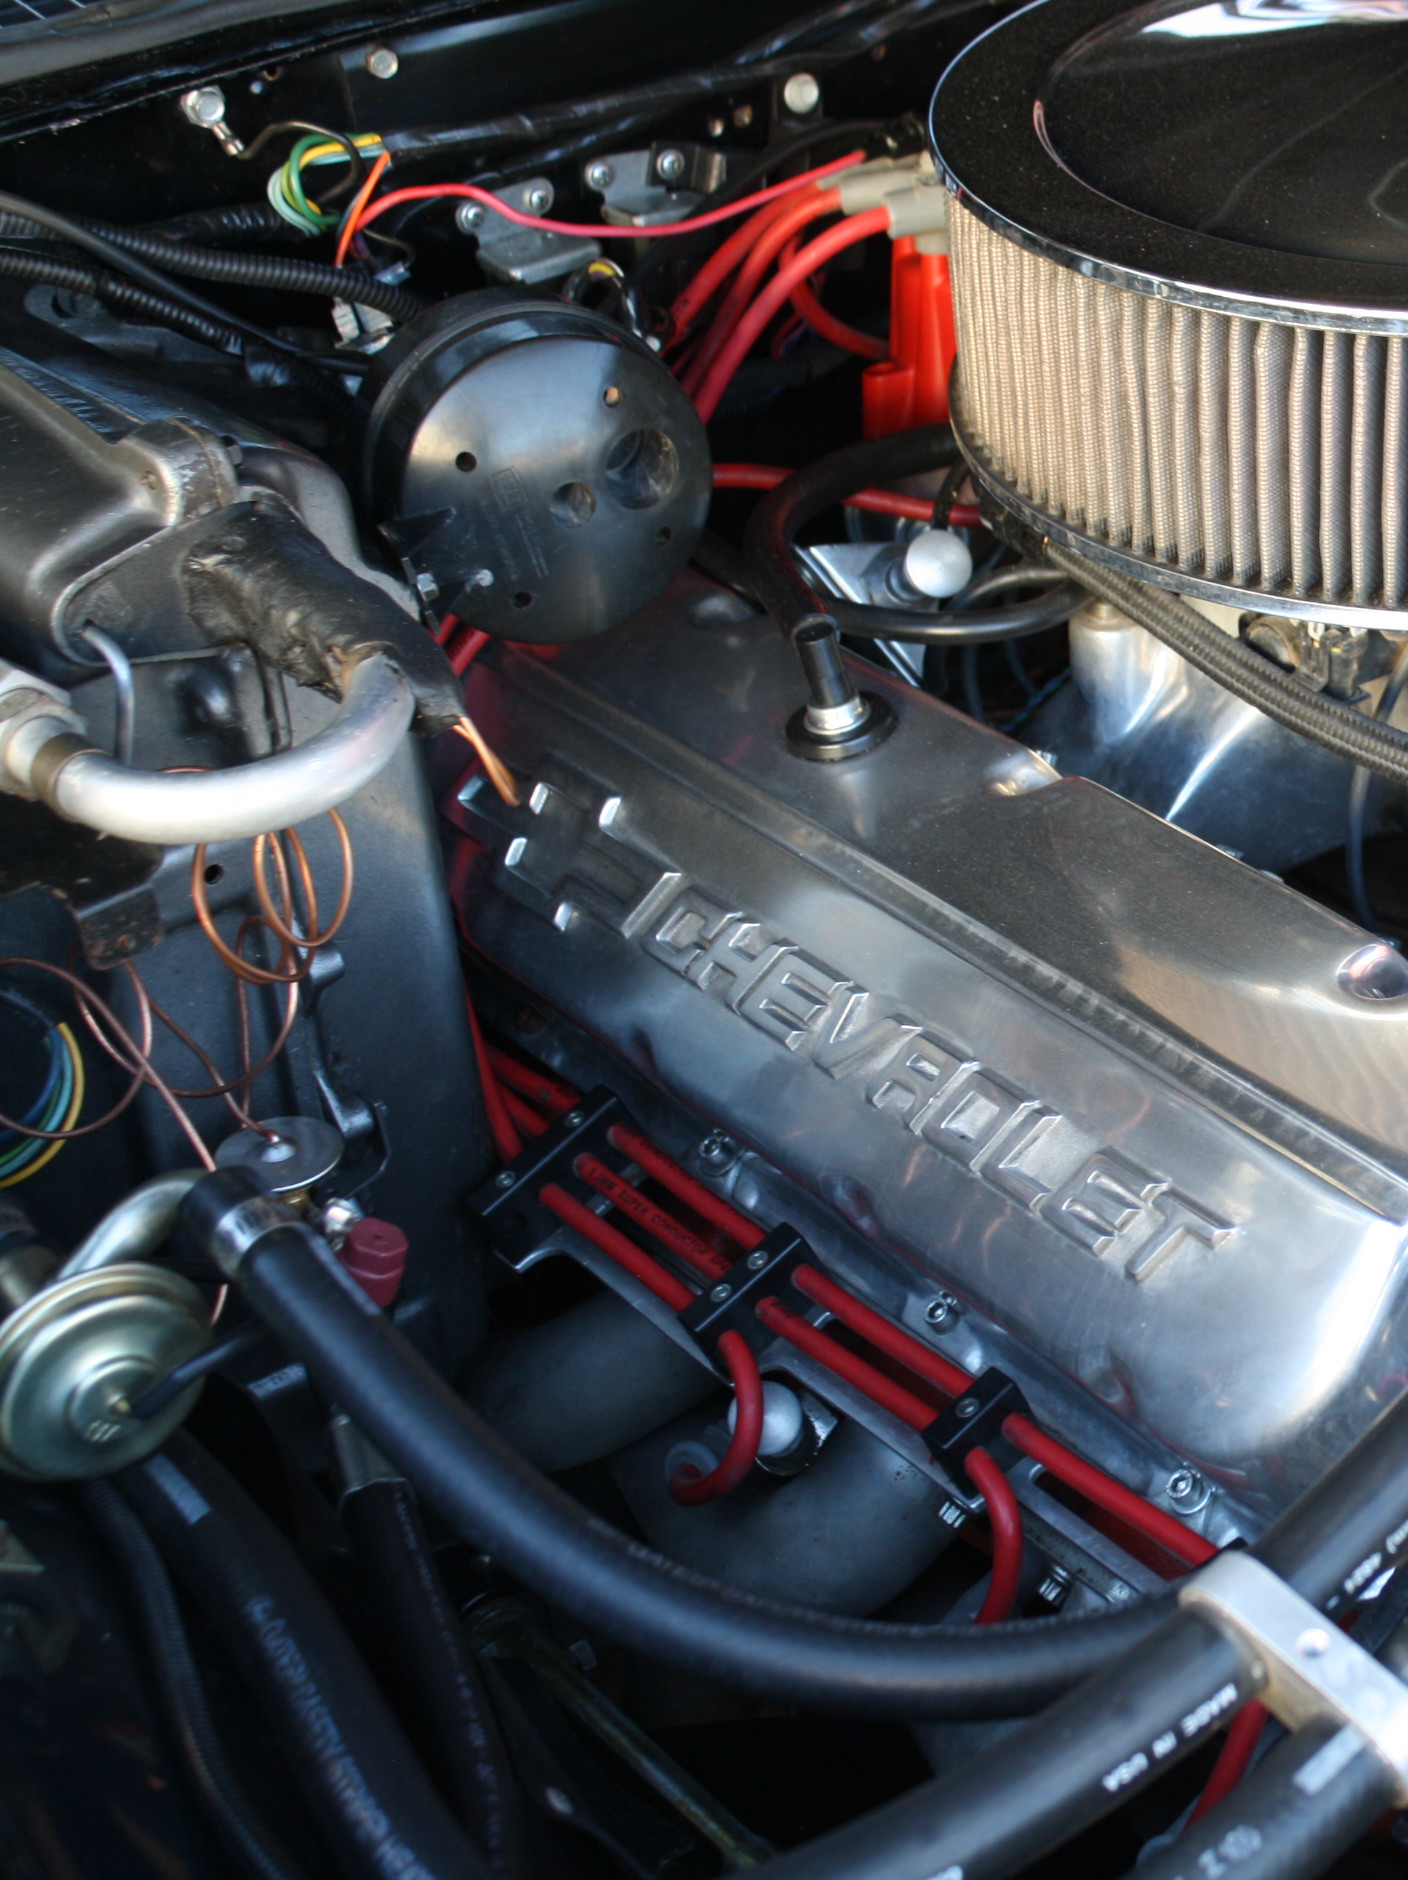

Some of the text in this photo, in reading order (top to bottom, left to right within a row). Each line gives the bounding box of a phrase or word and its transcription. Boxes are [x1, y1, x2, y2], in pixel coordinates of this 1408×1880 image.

[640, 885, 1239, 1282] CHEVROLET
[651, 1213, 706, 1256] CONDUCTOR
[1102, 1683, 1238, 1792] MADE IN USA
